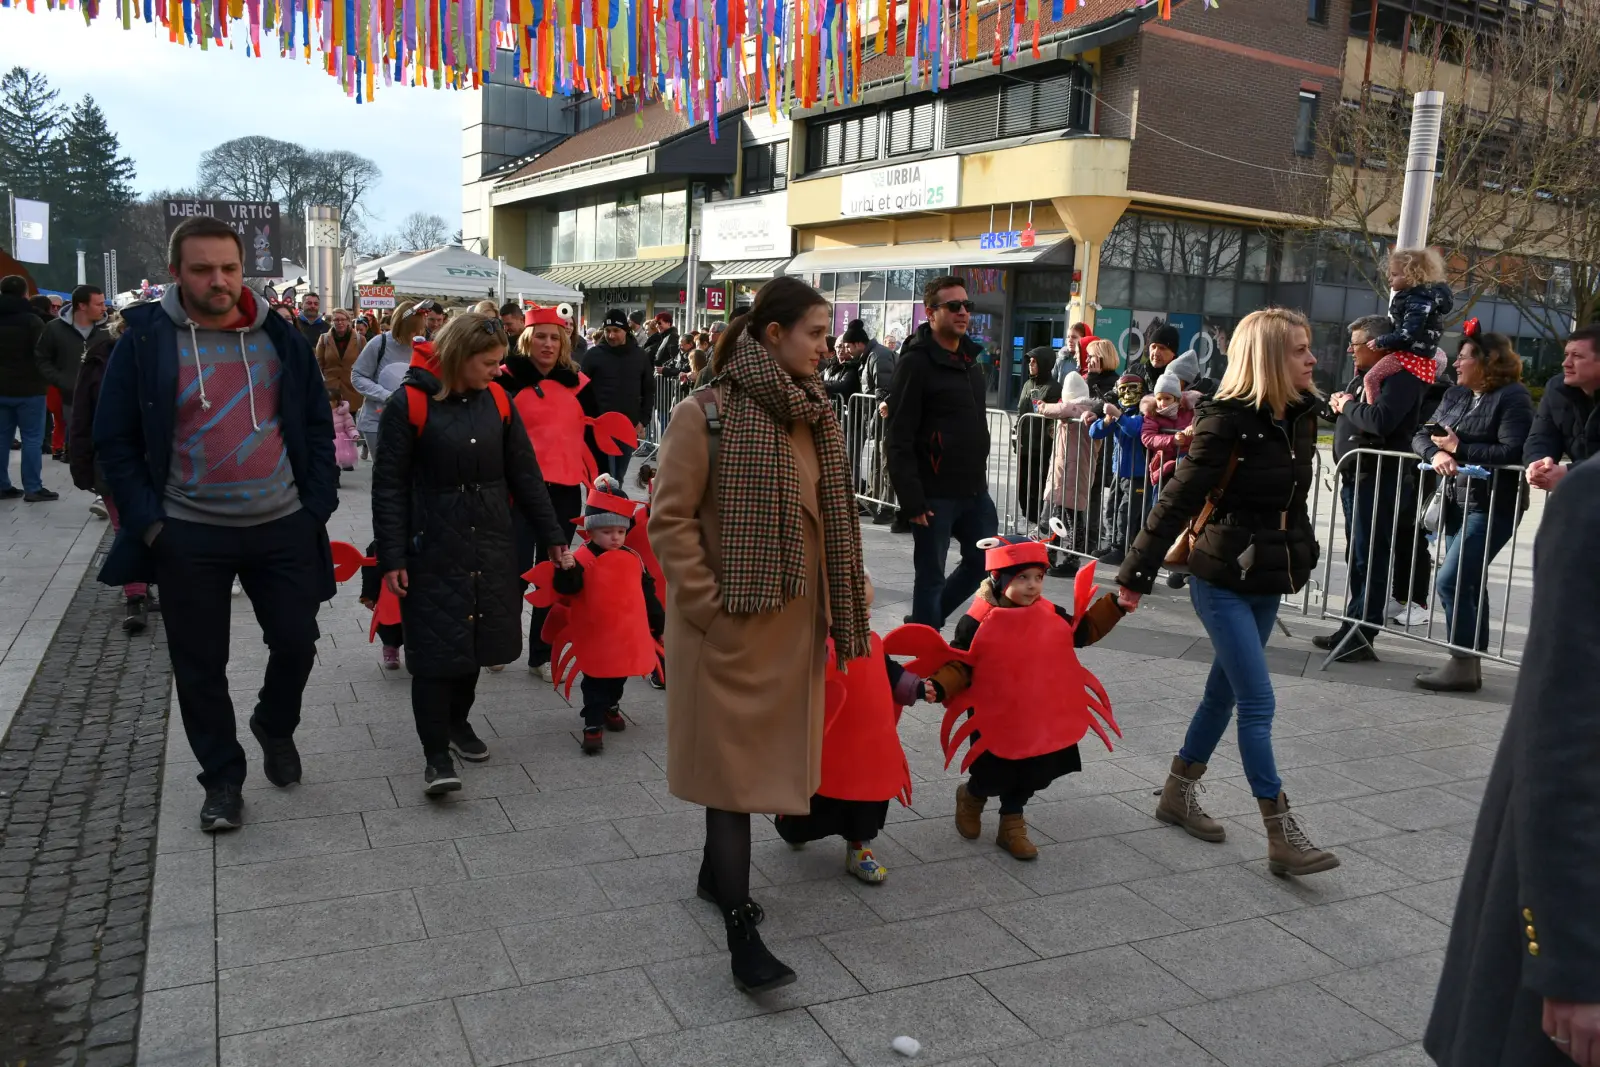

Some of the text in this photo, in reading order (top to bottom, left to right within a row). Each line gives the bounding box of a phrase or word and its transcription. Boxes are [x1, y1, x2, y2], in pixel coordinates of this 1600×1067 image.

[886, 166, 921, 186] URBIA
[850, 194, 874, 213] urbi
[878, 193, 891, 210] et
[926, 185, 944, 205] 25
[169, 200, 272, 219] DJEČJI VRTIĆ
[980, 231, 1020, 249] ERSTE
